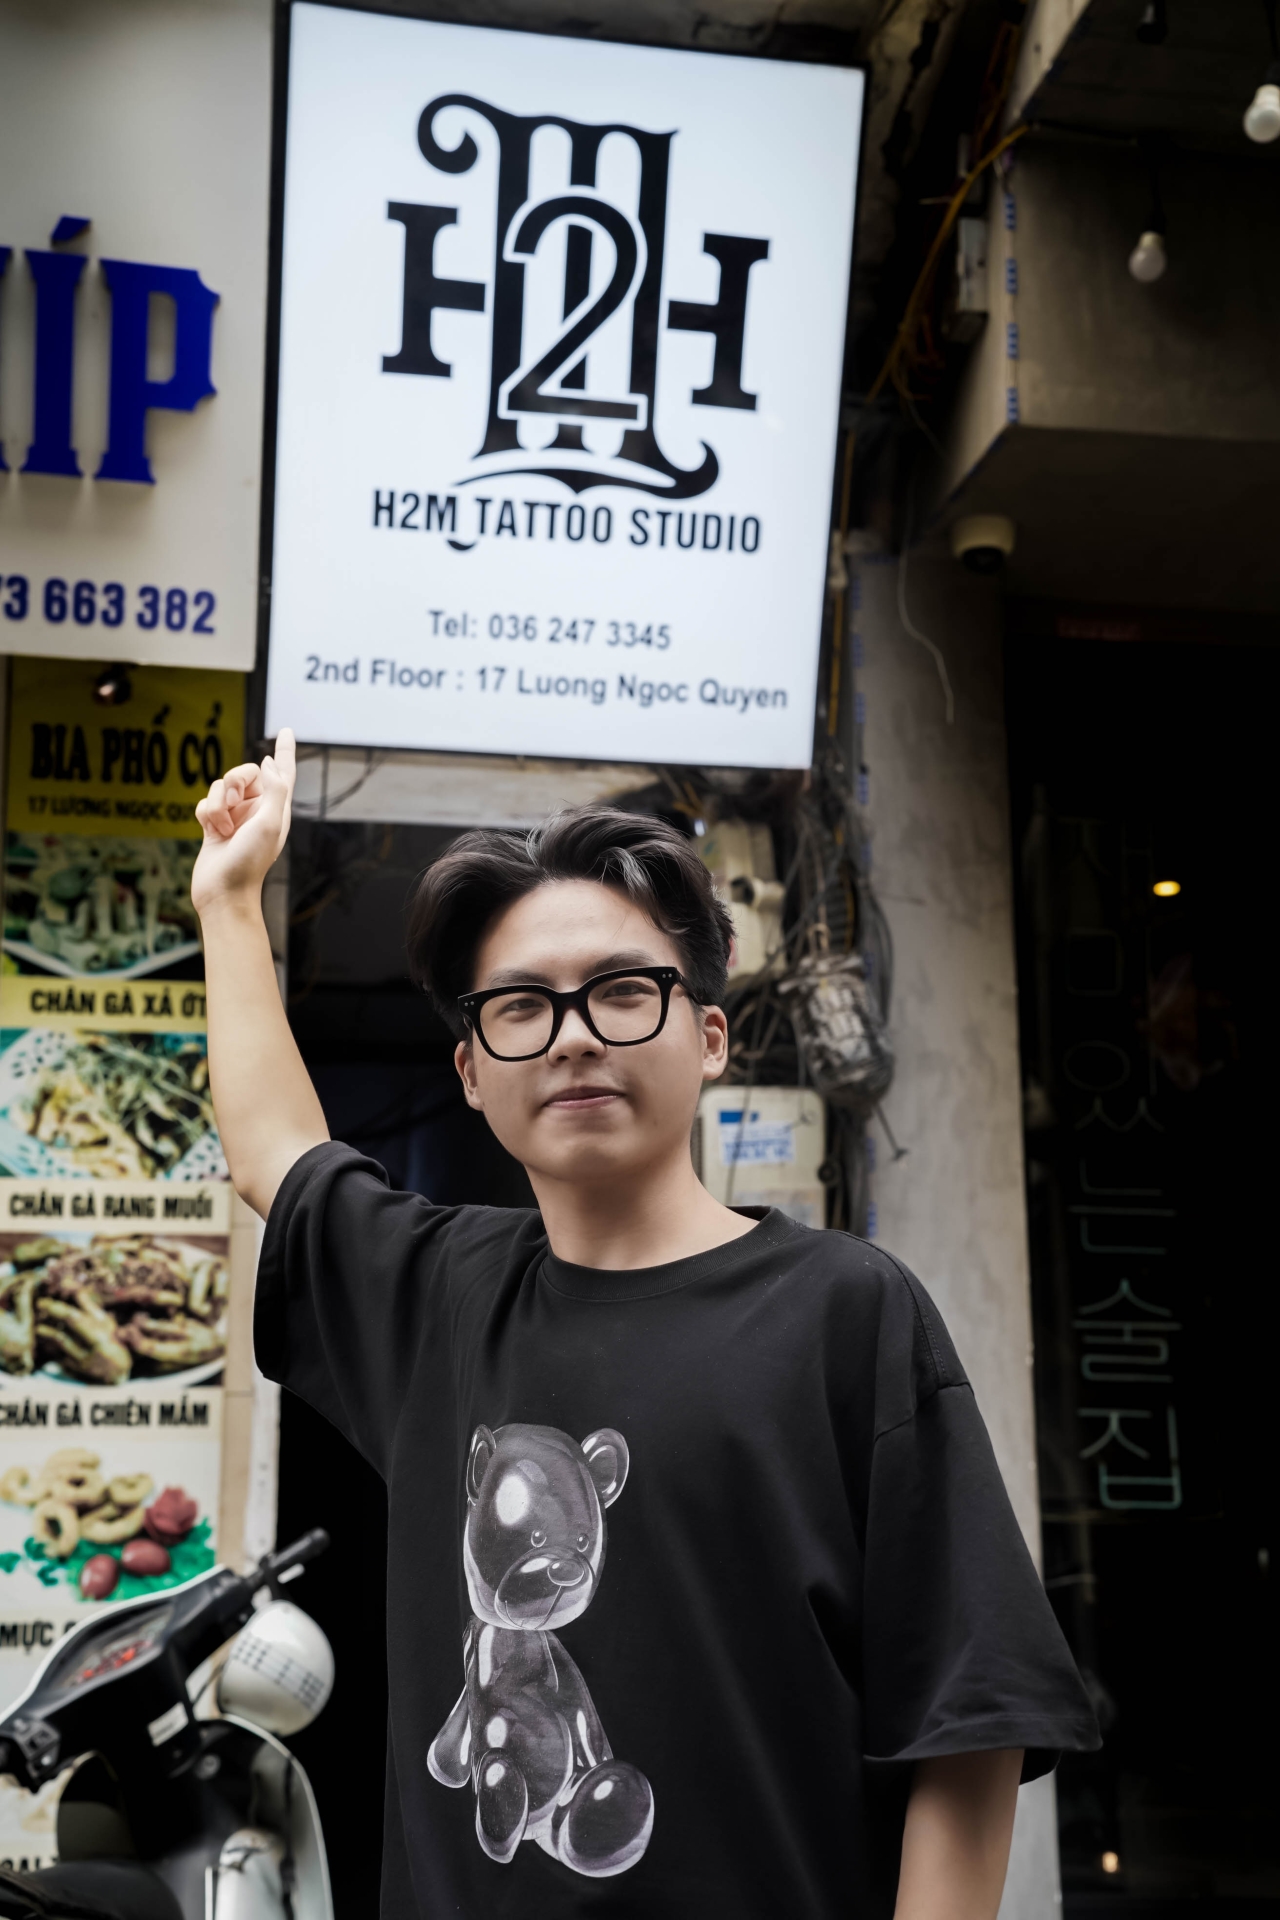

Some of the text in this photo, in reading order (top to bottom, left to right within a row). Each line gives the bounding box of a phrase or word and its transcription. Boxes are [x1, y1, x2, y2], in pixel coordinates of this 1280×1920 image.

[0, 215, 220, 484] ÍP
[374, 490, 761, 553] H2M TATTOO STUDIO
[0, 574, 216, 635] 3 663 382
[428, 610, 671, 650] Tel: 036 247 3345
[305, 655, 360, 684] 2nd
[370, 659, 446, 689] Floor
[477, 667, 507, 691] 17
[517, 669, 607, 705] Luong
[617, 673, 689, 708] Ngoc
[699, 679, 788, 714] Quyen
[31, 702, 223, 787] BIA PHỐ CỔ
[30, 986, 96, 1015] CHÂN
[104, 989, 135, 1016] GÀ
[9, 1187, 213, 1220] CHÂN GÀ RANG MUỐI
[56, 1398, 83, 1427] GÀ
